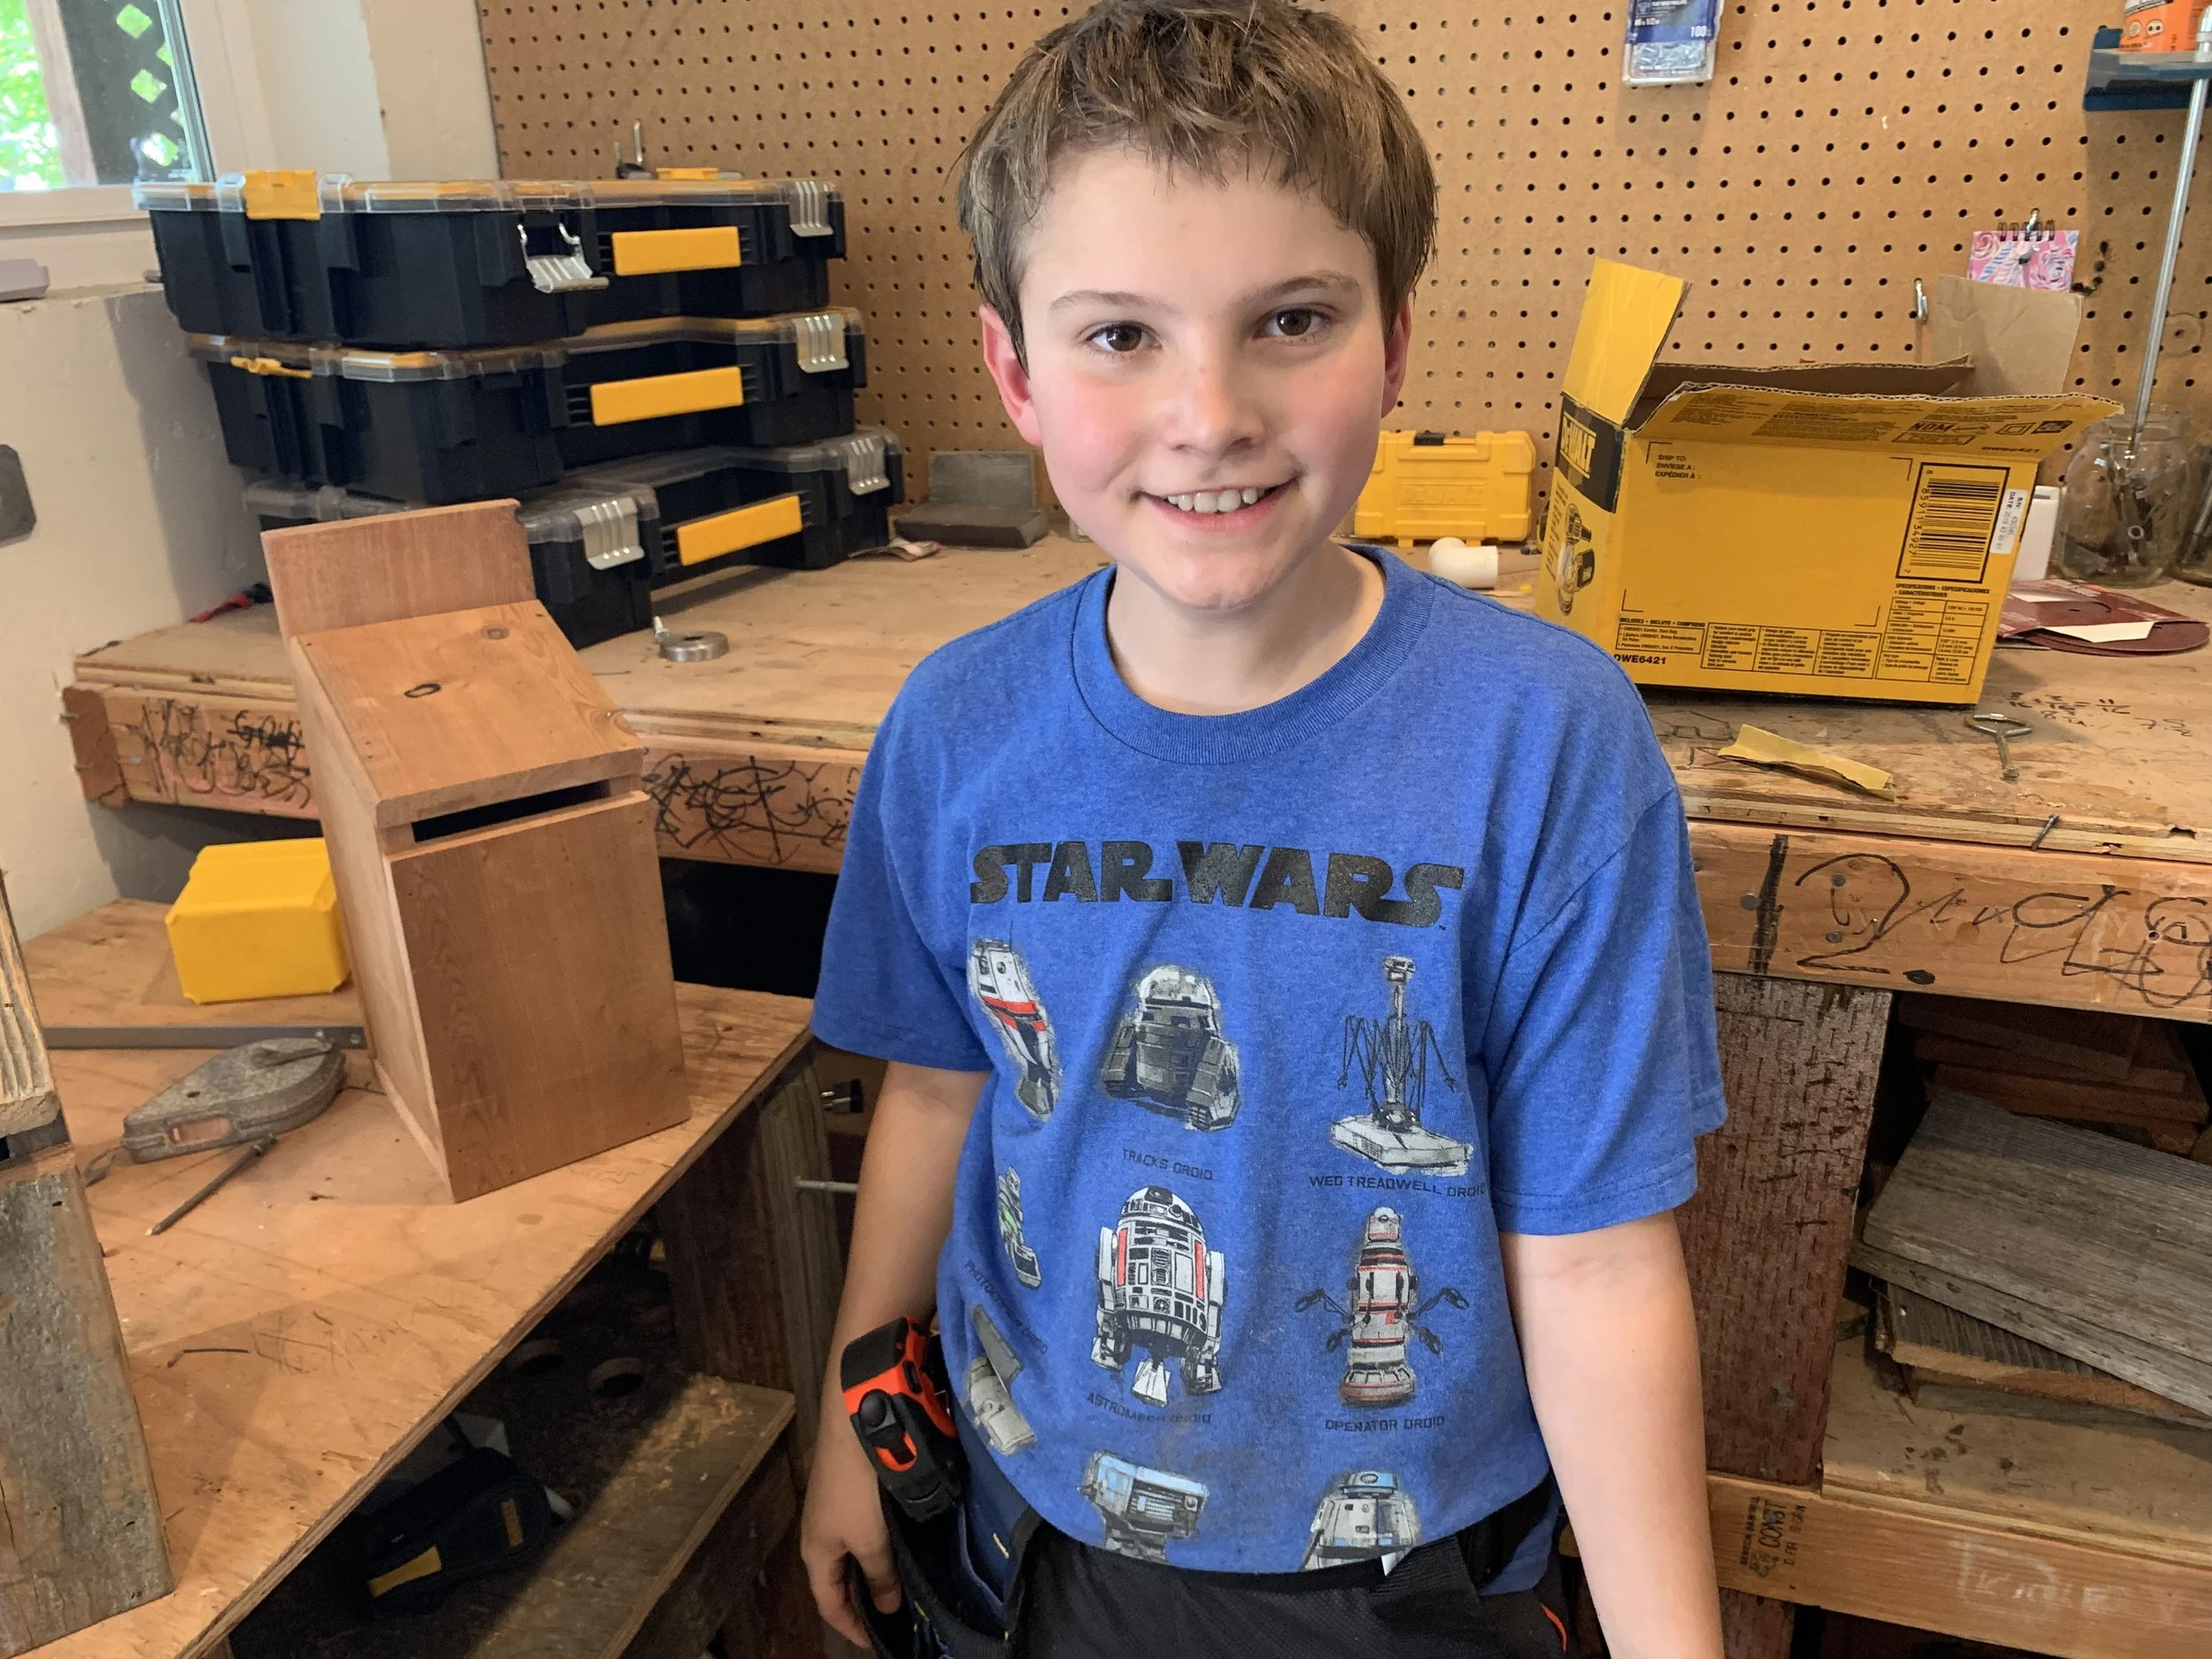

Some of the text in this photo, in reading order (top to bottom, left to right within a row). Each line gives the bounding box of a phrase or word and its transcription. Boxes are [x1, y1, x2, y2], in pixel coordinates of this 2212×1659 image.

[1691, 26, 1707, 37] 100
[971, 841, 1465, 927] STAR WARS
[1123, 1148, 1213, 1180] TRACKS DROID
[1310, 1175, 1343, 1187] WED
[1347, 1176, 1441, 1194] TREADWELL
[1325, 1416, 1445, 1432] OPERATOR DROID
